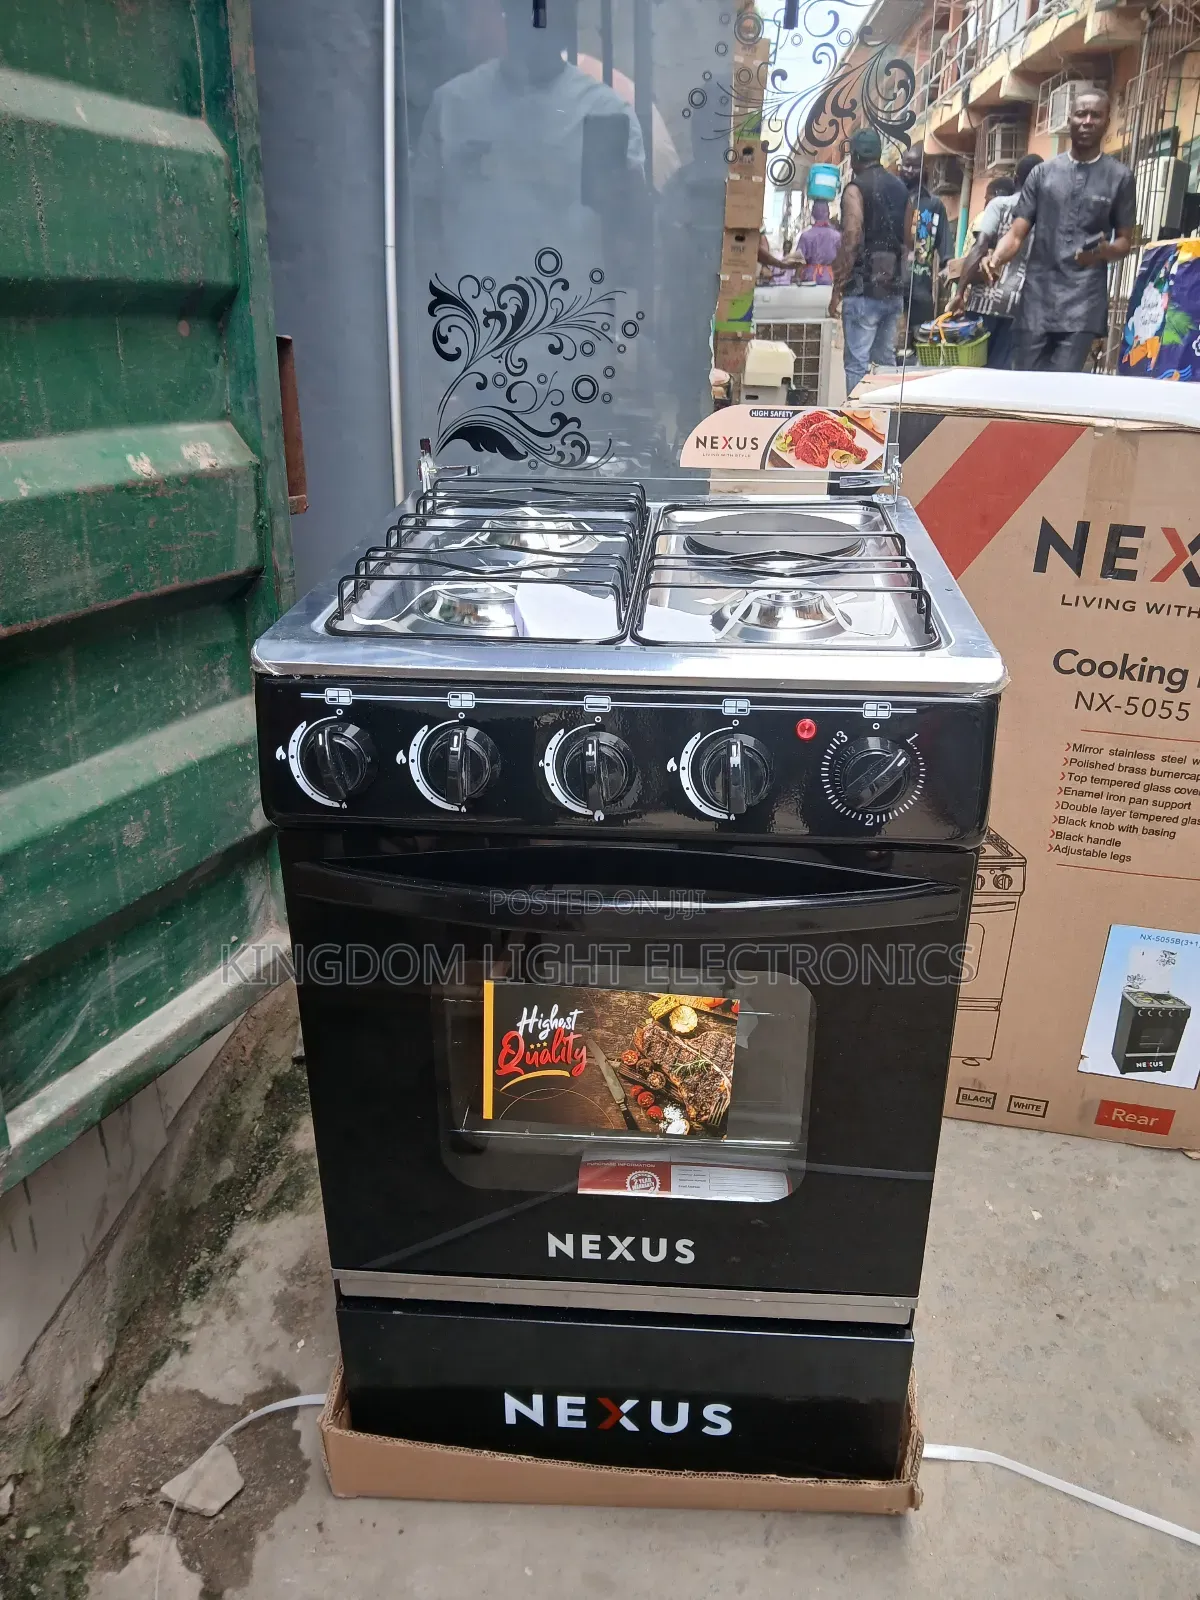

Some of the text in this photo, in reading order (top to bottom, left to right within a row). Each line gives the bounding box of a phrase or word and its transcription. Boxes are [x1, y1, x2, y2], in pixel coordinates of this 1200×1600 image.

[751, 410, 794, 418] HIGH SAFETY
[695, 435, 759, 451] NEXUS
[1060, 593, 1200, 619] LIVING WITH
[1052, 648, 1190, 694] Cooking
[1074, 690, 1192, 722] NX-5055
[836, 730, 848, 743] 3
[906, 732, 919, 744] 1
[1072, 743, 1104, 755] Mirror
[1109, 747, 1156, 761] stainless
[1161, 754, 1187, 765] steel
[1069, 757, 1115, 772] Polished
[1117, 762, 1147, 775] brass
[1067, 772, 1087, 784] Top
[1090, 775, 1141, 790] tempered
[1143, 782, 1171, 793] glass
[1063, 786, 1192, 811] Enamel iron pan support
[865, 813, 874, 826] 2
[1060, 801, 1098, 814] Double
[1100, 806, 1127, 818] layer
[1129, 809, 1179, 824] tempered
[1058, 815, 1176, 840] Black knob with basing
[1055, 830, 1122, 848] Black handle
[1052, 844, 1132, 864] Adjustable legs
[516, 1004, 584, 1041] Highest
[495, 1027, 588, 1078] Quality
[1135, 1061, 1164, 1069] NEXUS
[961, 1093, 993, 1105] BLACK
[1013, 1101, 1042, 1113] WHITE
[1112, 1107, 1160, 1127] Rear
[547, 1231, 696, 1265] NEXUS
[503, 1391, 733, 1437] NEXUS
